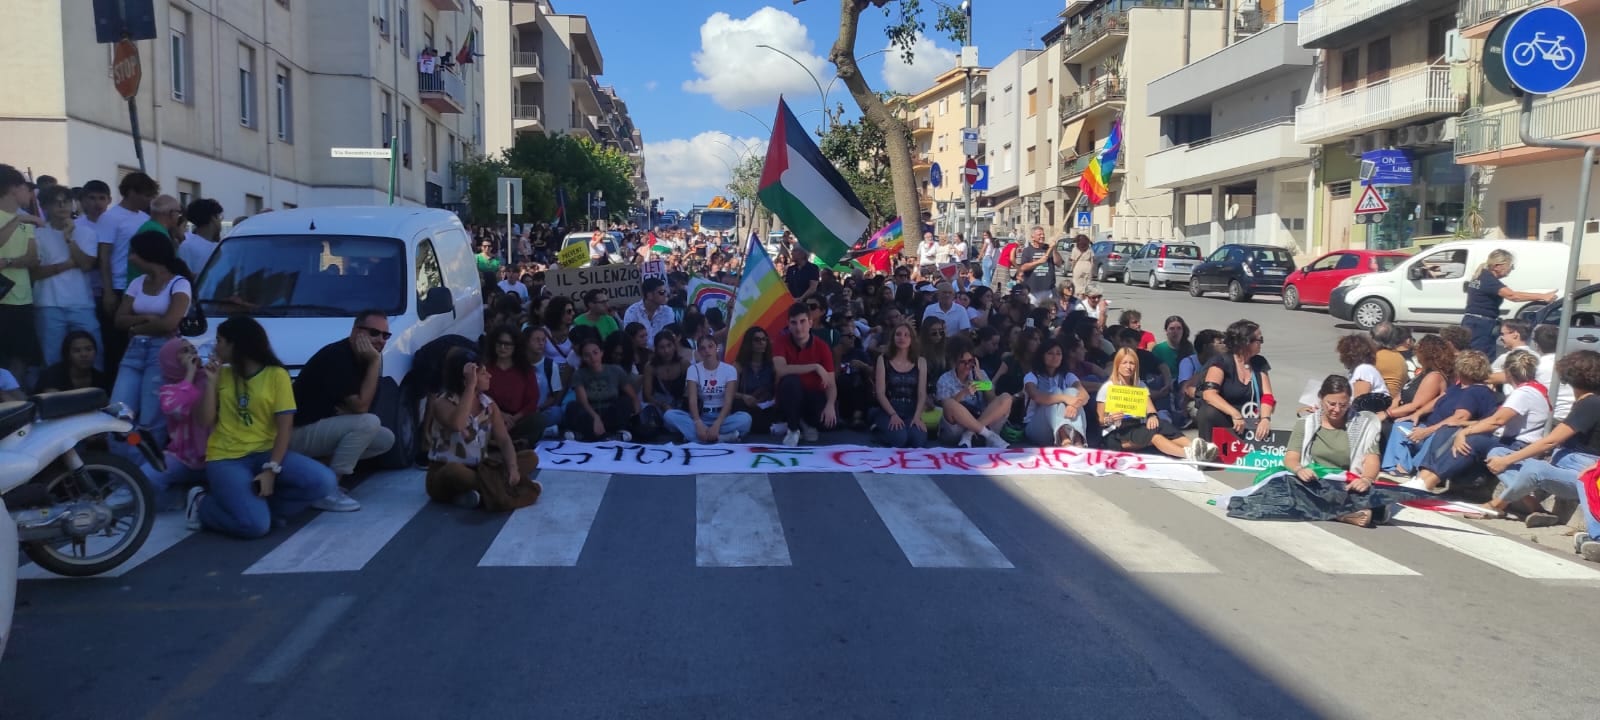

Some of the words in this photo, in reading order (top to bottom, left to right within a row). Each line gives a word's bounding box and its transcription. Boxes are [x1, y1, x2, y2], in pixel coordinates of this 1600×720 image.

[114, 57, 139, 85] STOP
[1382, 156, 1396, 164] ON
[644, 260, 661, 273] LET
[556, 273, 573, 287] IL
[578, 268, 640, 286] SILENZIO
[545, 442, 735, 466] STOP
[1236, 456, 1246, 466] DI
